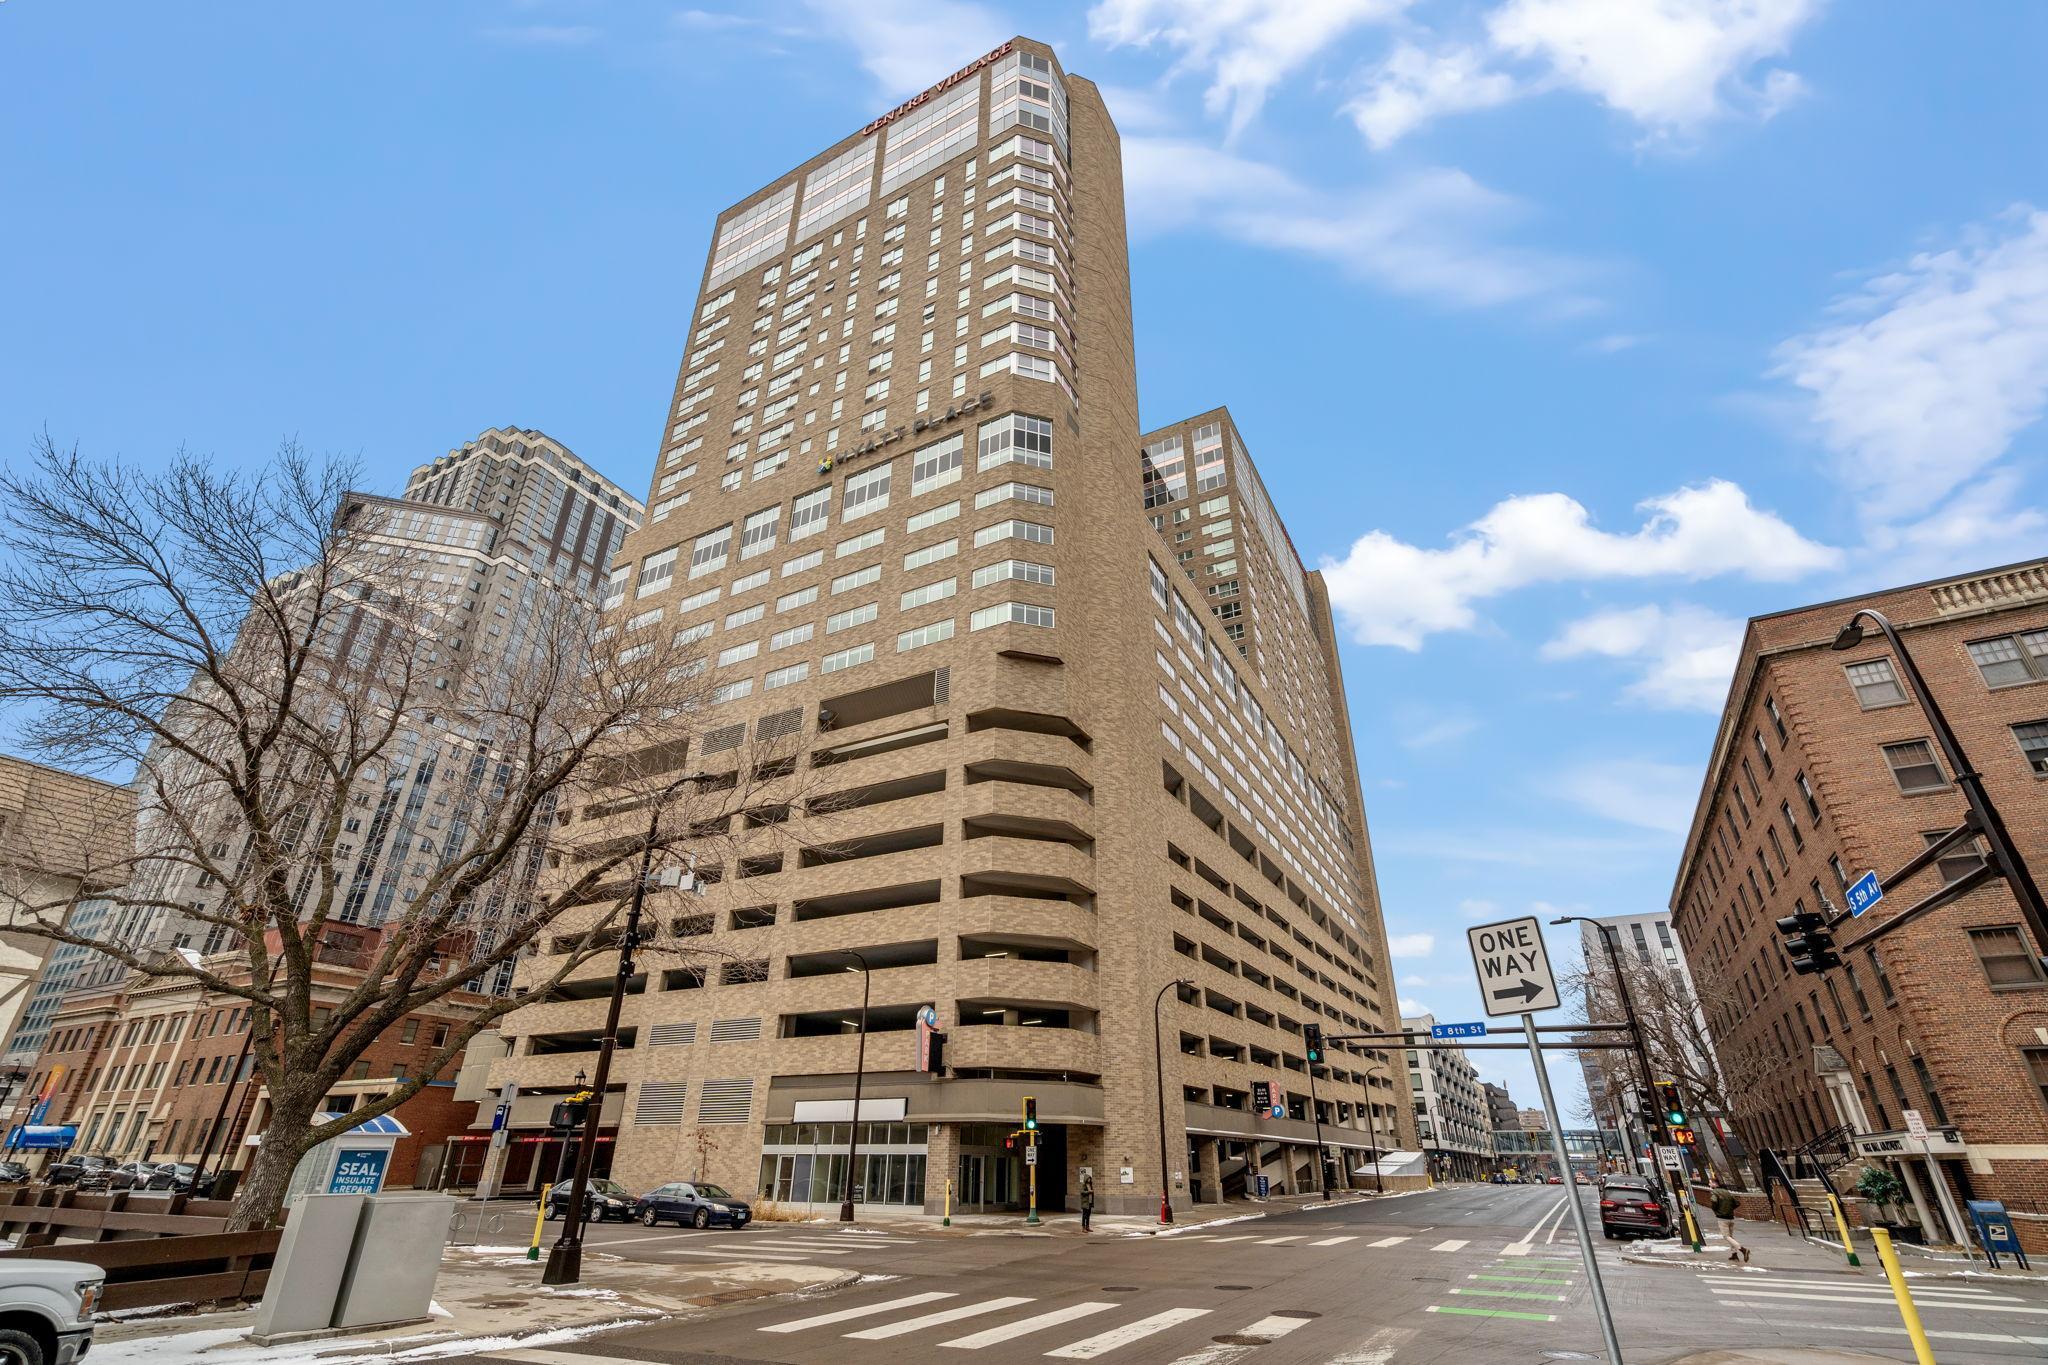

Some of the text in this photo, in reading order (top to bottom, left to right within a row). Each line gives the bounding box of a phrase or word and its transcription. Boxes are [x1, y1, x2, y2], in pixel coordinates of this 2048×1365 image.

[862, 41, 1013, 136] CENTRE VILLAGE
[835, 389, 996, 466] HYATT PLACE
[1849, 880, 1879, 911] S 5th Av
[1480, 926, 1533, 953] ONE
[1482, 950, 1537, 978] WAY
[929, 1011, 935, 1023] P
[1435, 1025, 1482, 1036] S 8th St
[1274, 1106, 1280, 1115] P
[338, 1162, 380, 1177] SEAL,
[335, 1176, 376, 1185] INSULATE
[339, 1185, 373, 1194] REPAIR
